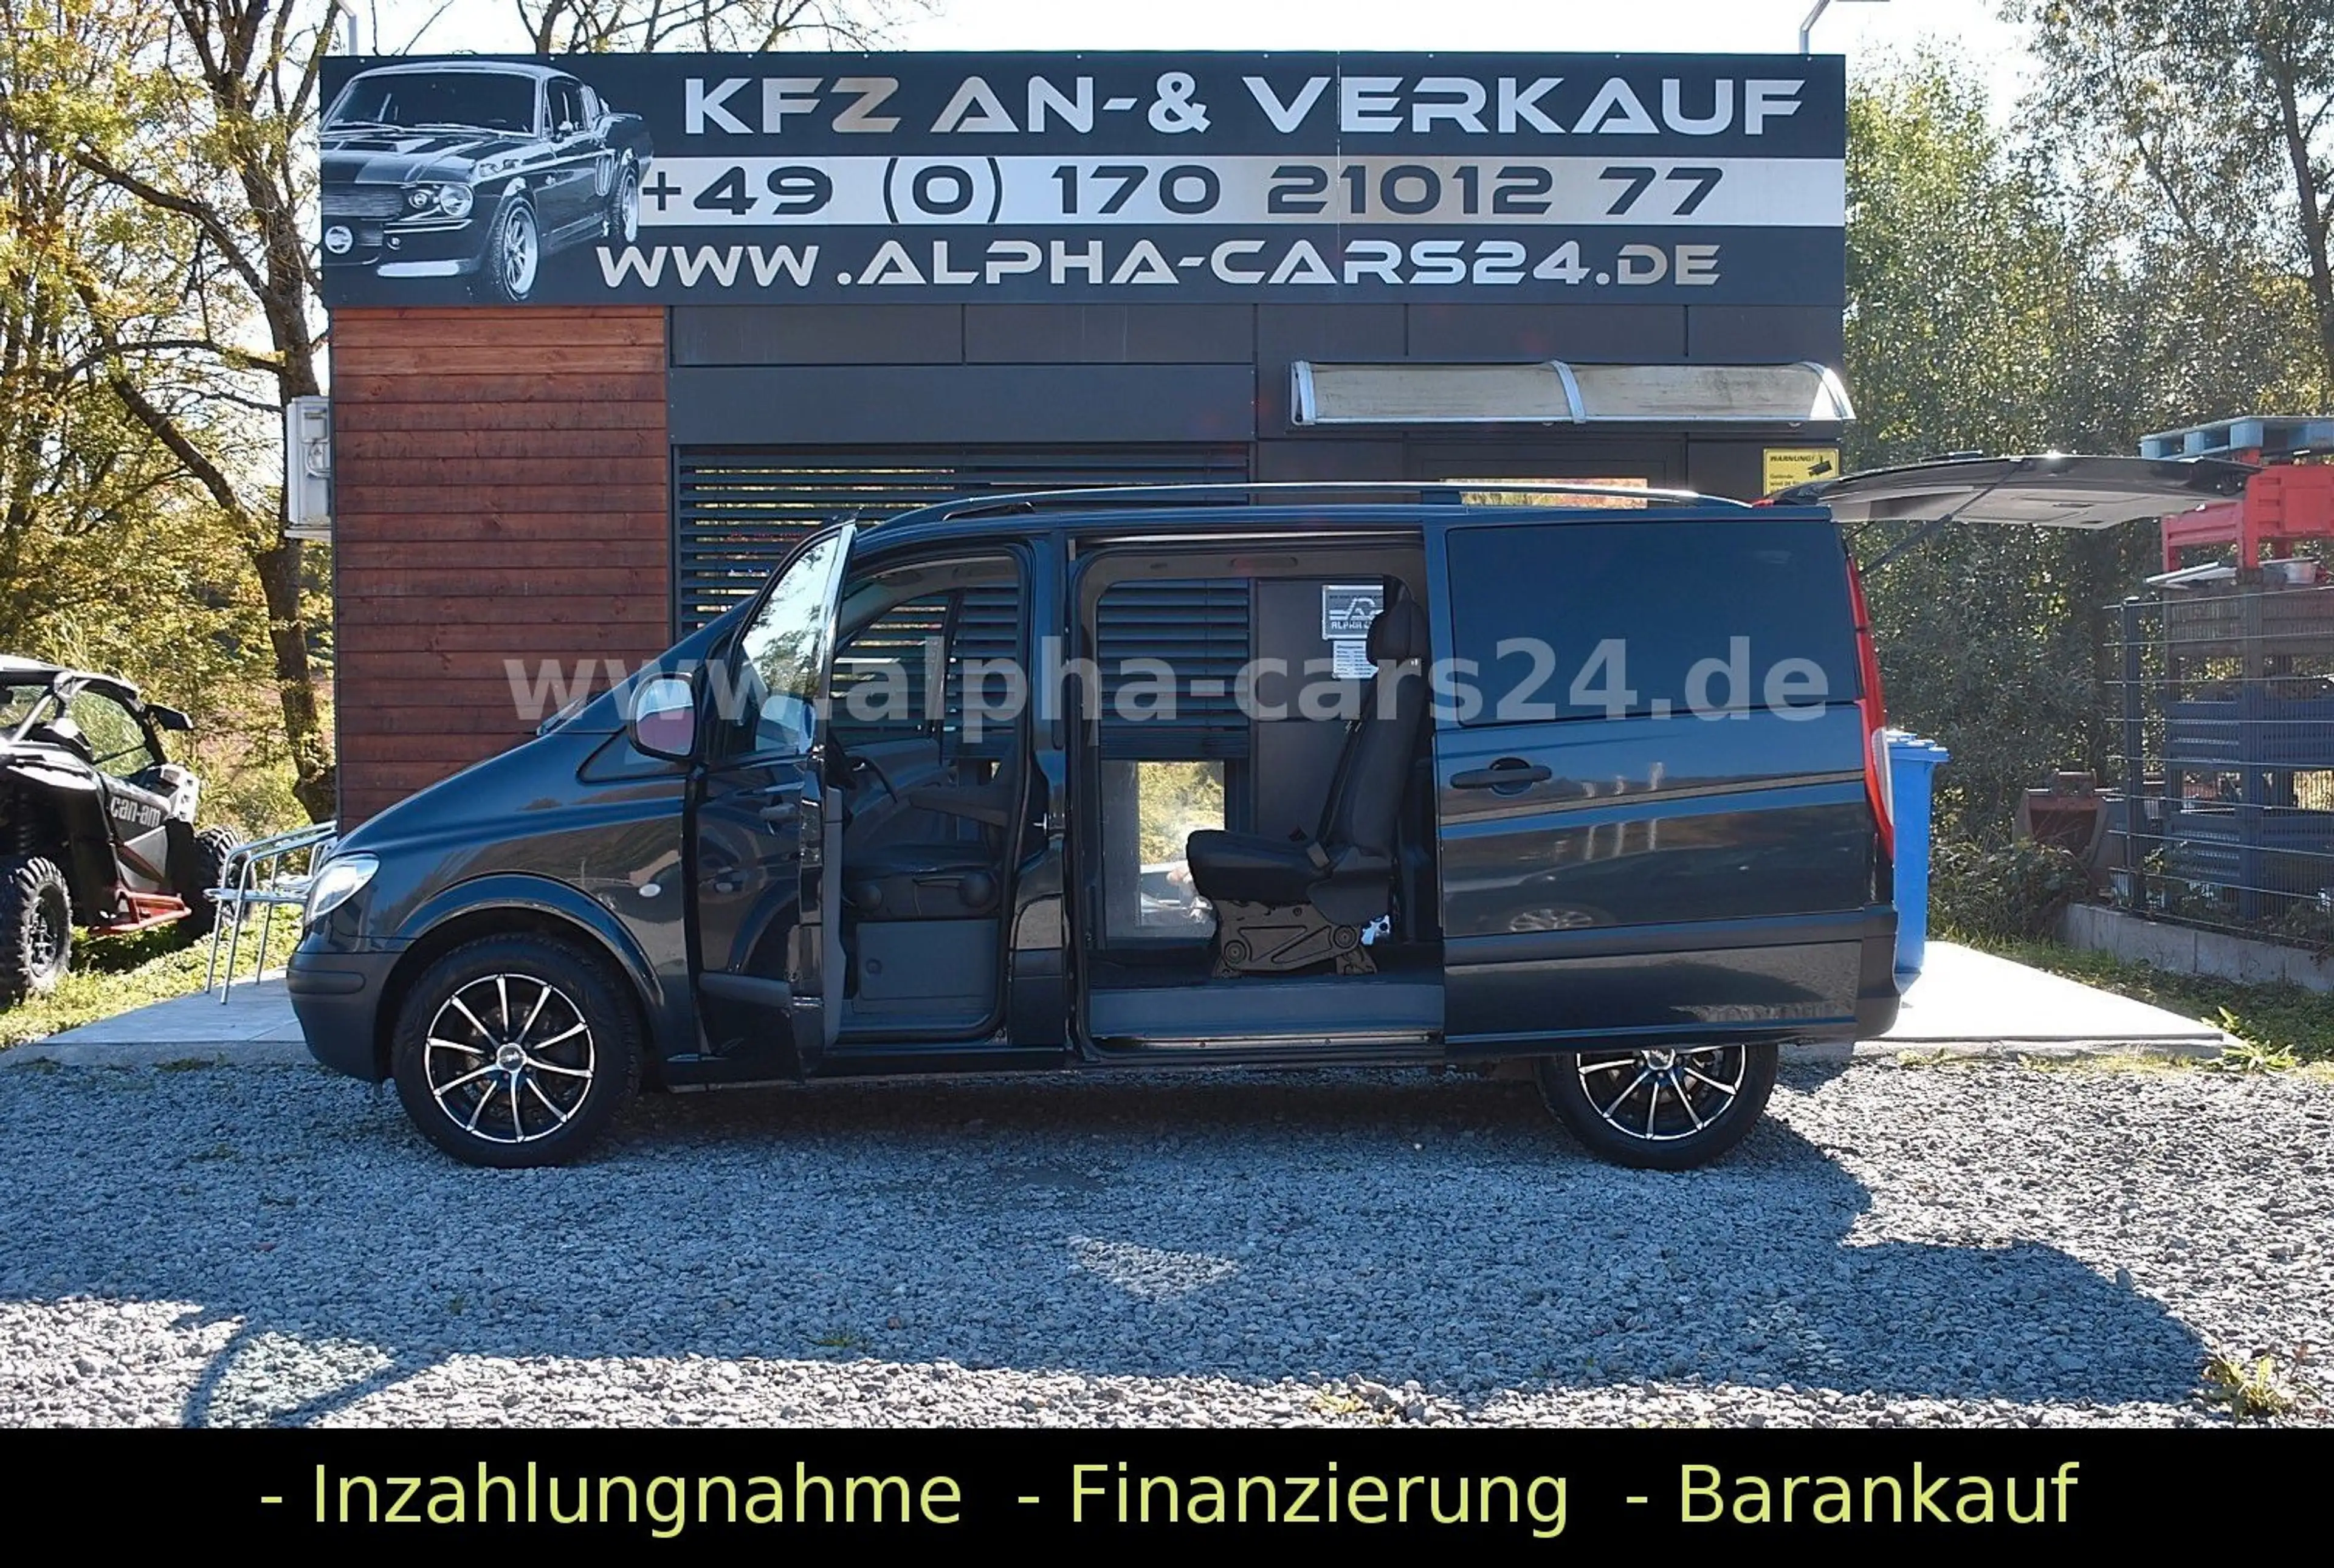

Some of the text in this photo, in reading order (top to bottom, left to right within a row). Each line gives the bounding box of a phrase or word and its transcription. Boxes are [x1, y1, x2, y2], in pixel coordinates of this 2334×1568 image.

[685, 77, 901, 134] KFZ
[1241, 75, 1806, 136] VERKAUF
[642, 156, 1724, 224] +49 (0) 170 21012 77
[110, 796, 161, 828] can-am
